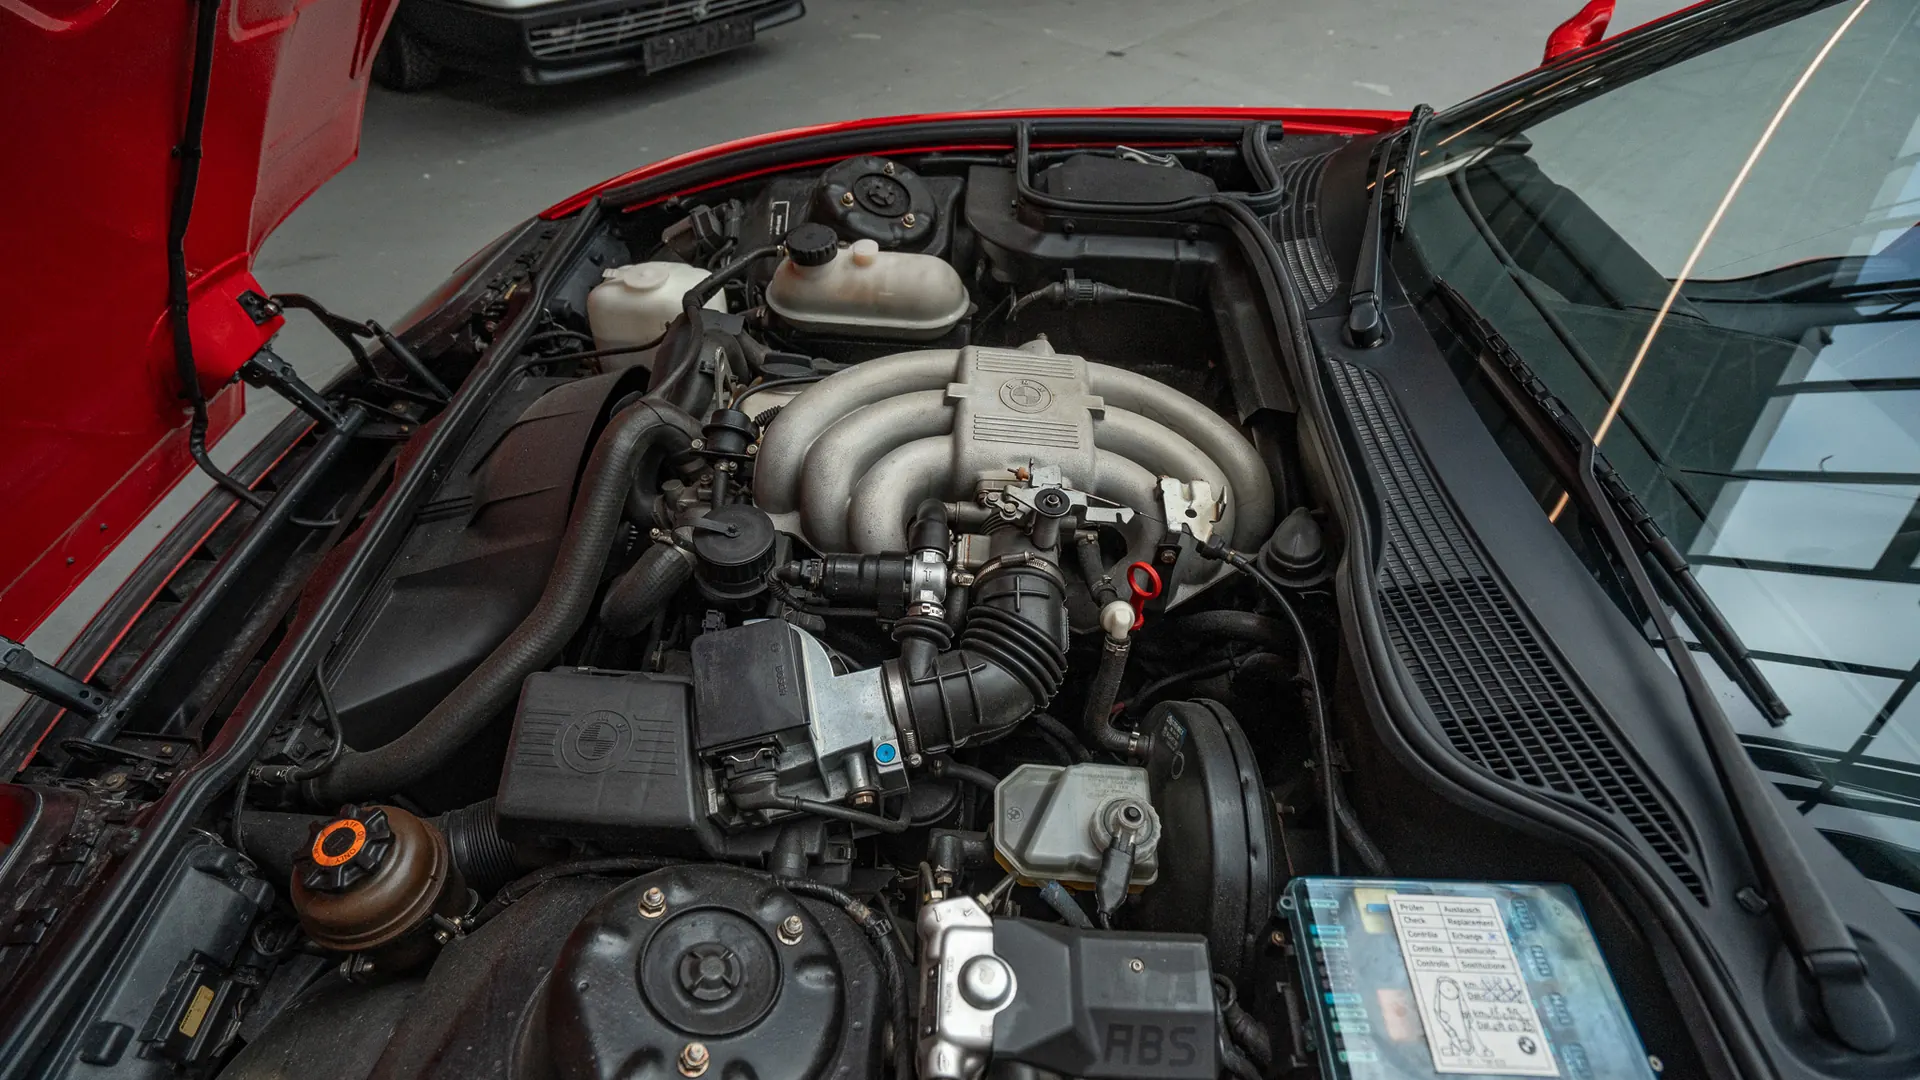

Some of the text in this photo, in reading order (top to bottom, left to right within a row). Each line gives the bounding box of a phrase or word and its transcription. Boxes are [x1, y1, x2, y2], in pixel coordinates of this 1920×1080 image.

[775, 665, 788, 696] BOSCH
[344, 820, 360, 828] ATF
[335, 848, 357, 864] ONLY
[1404, 916, 1494, 927] Check Replacement
[1103, 1023, 1196, 1067] ABS
